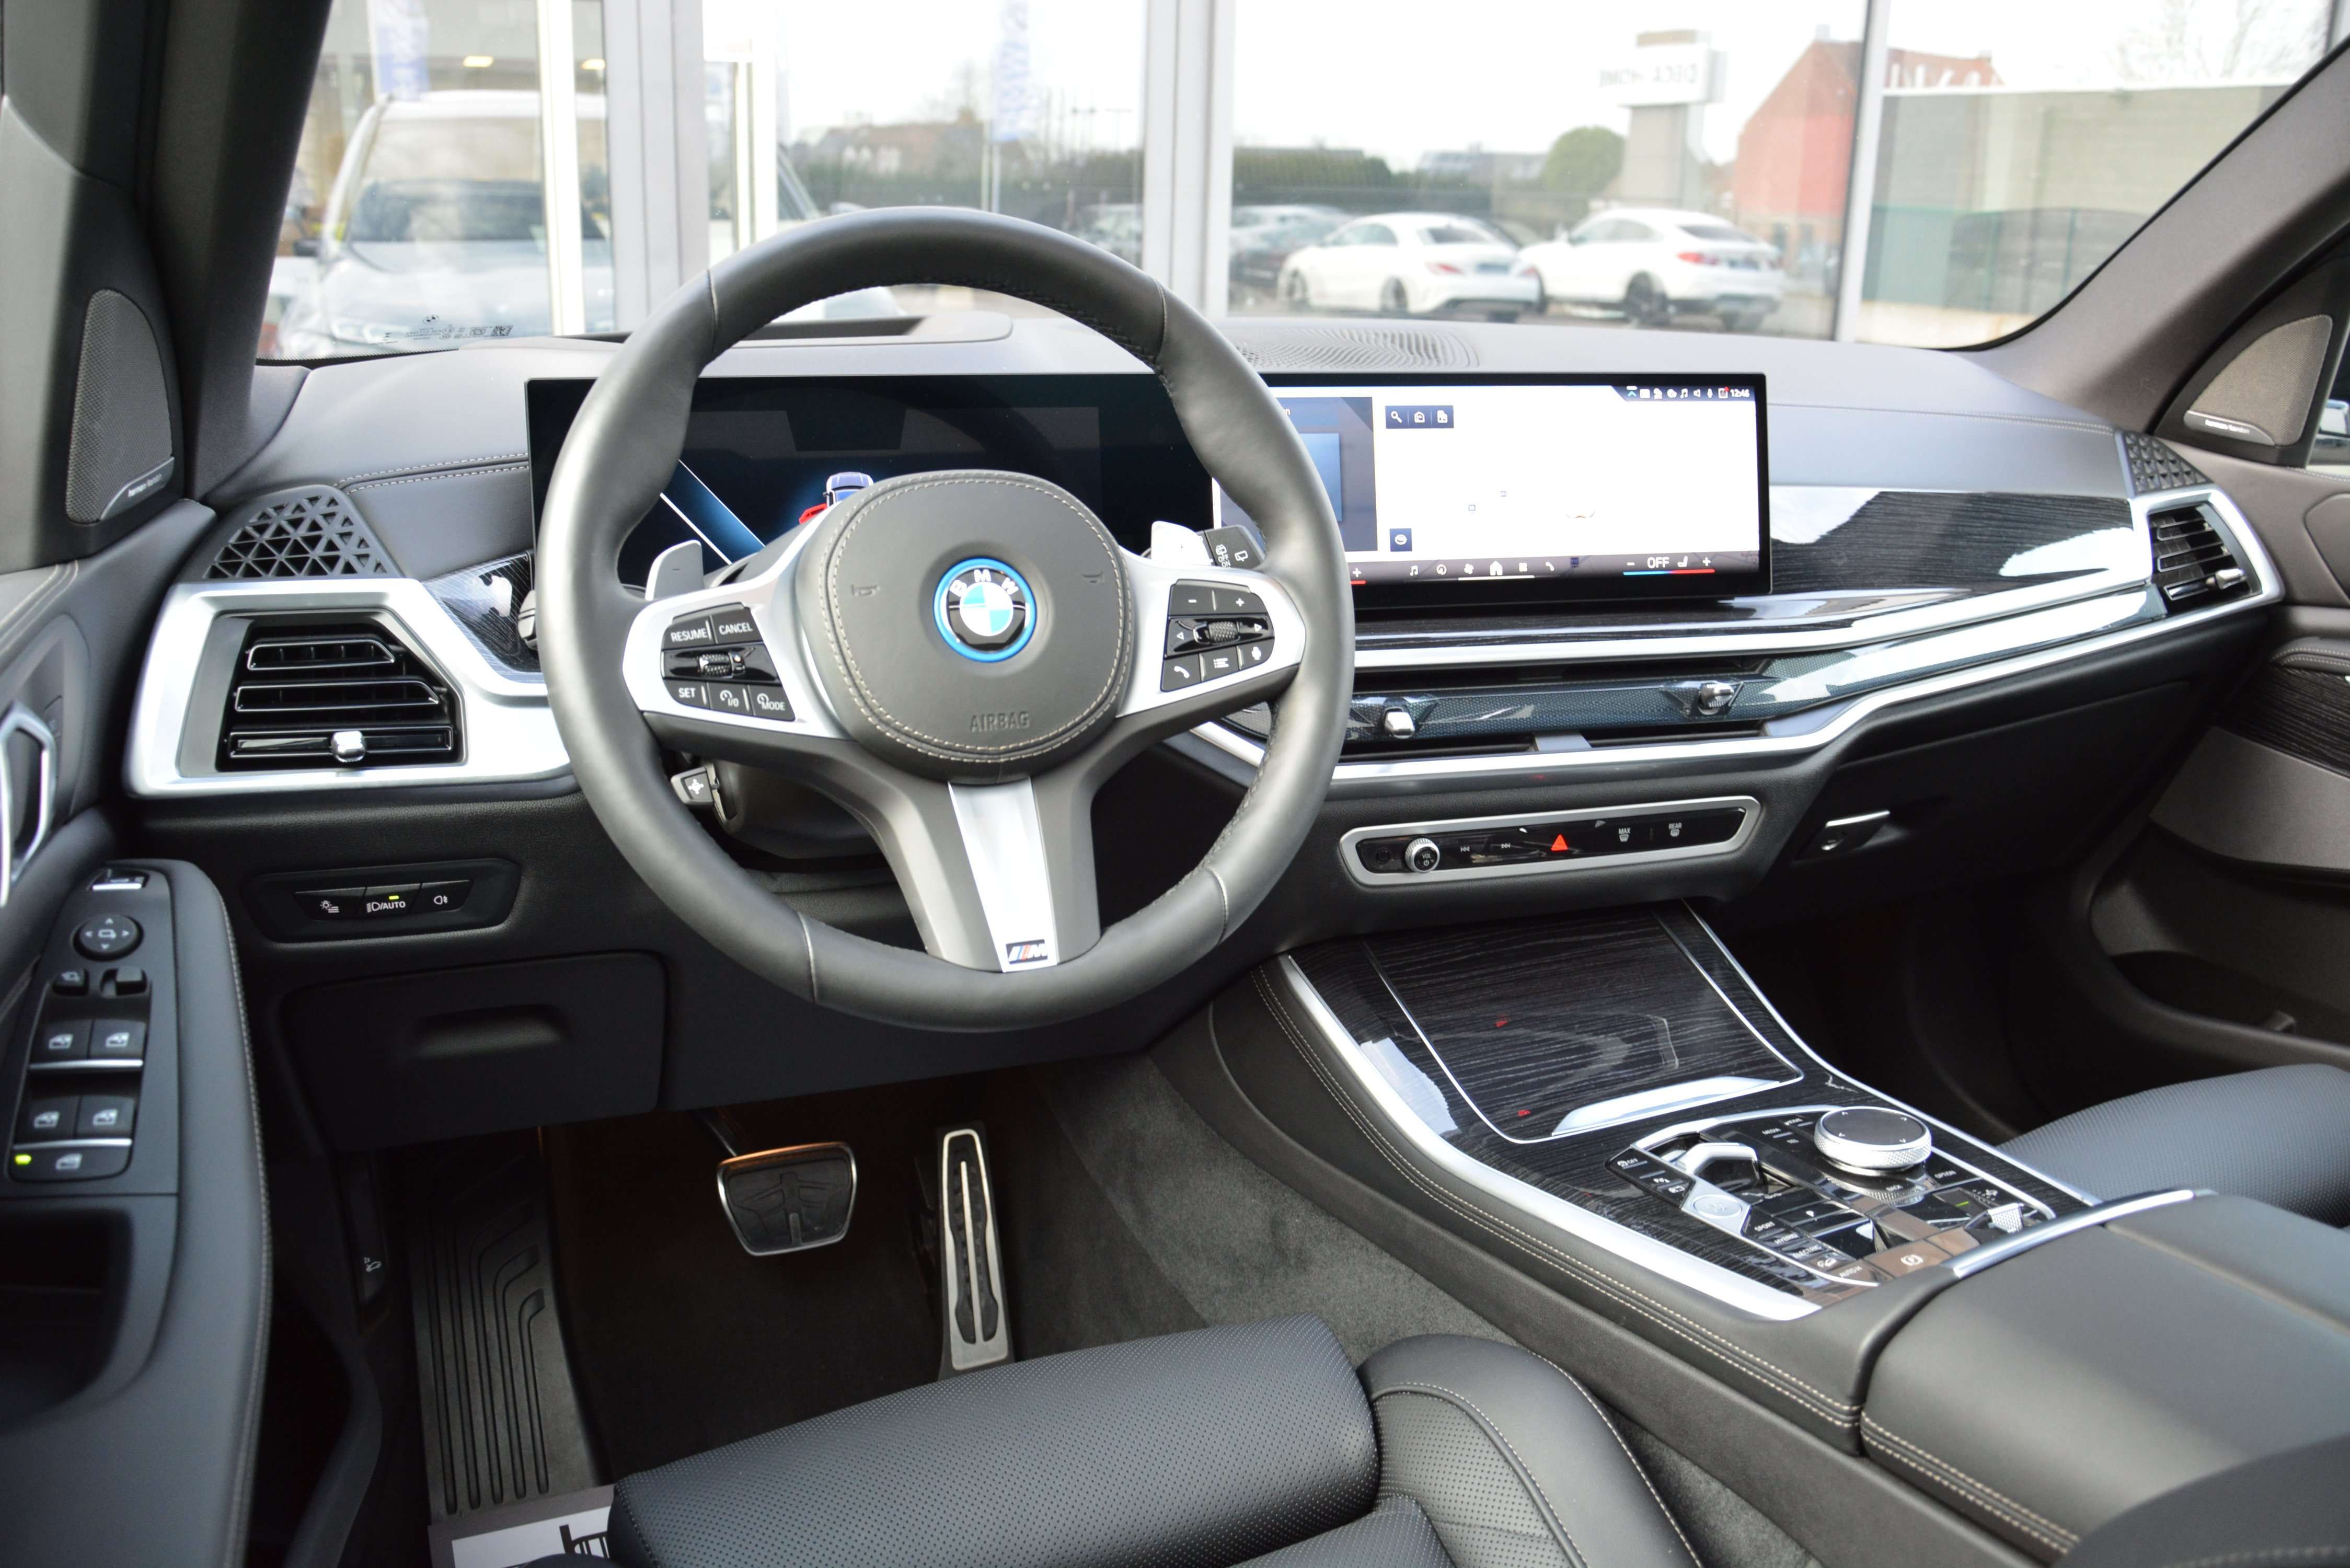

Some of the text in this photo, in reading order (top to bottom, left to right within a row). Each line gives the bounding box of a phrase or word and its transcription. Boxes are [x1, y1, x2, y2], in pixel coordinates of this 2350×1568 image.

[1218, 554, 1229, 562] OFF
[1647, 557, 1669, 569] OFF
[950, 569, 1018, 596] BMW
[719, 622, 753, 635] CANCEL
[671, 628, 707, 642] RESUME
[678, 688, 695, 698] SET
[762, 701, 785, 711] MODE
[970, 711, 1030, 732] AIRBAG
[1934, 1170, 1956, 1179] OPTION
[1754, 1221, 1775, 1232] SPORT
